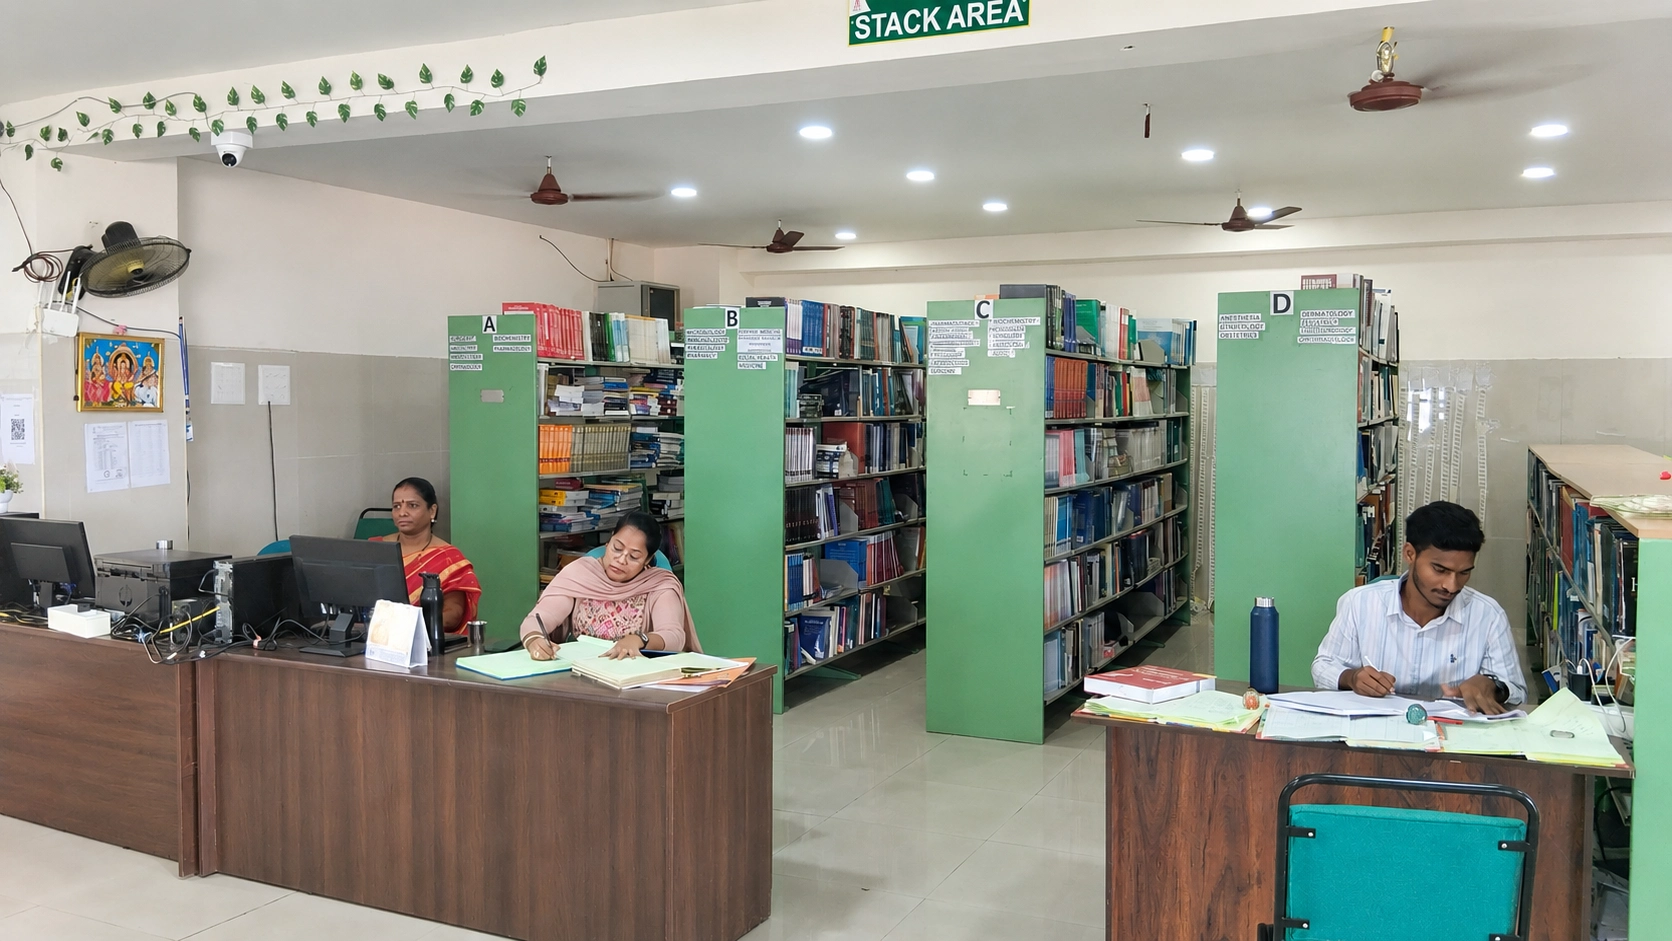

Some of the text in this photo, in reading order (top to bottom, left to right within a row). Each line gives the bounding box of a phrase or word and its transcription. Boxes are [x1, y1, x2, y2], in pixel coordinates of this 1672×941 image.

[855, 0, 1024, 39] STACK AREA
[976, 300, 990, 319] C
[1273, 293, 1291, 314] D
[484, 316, 495, 332] A
[727, 310, 738, 327] B
